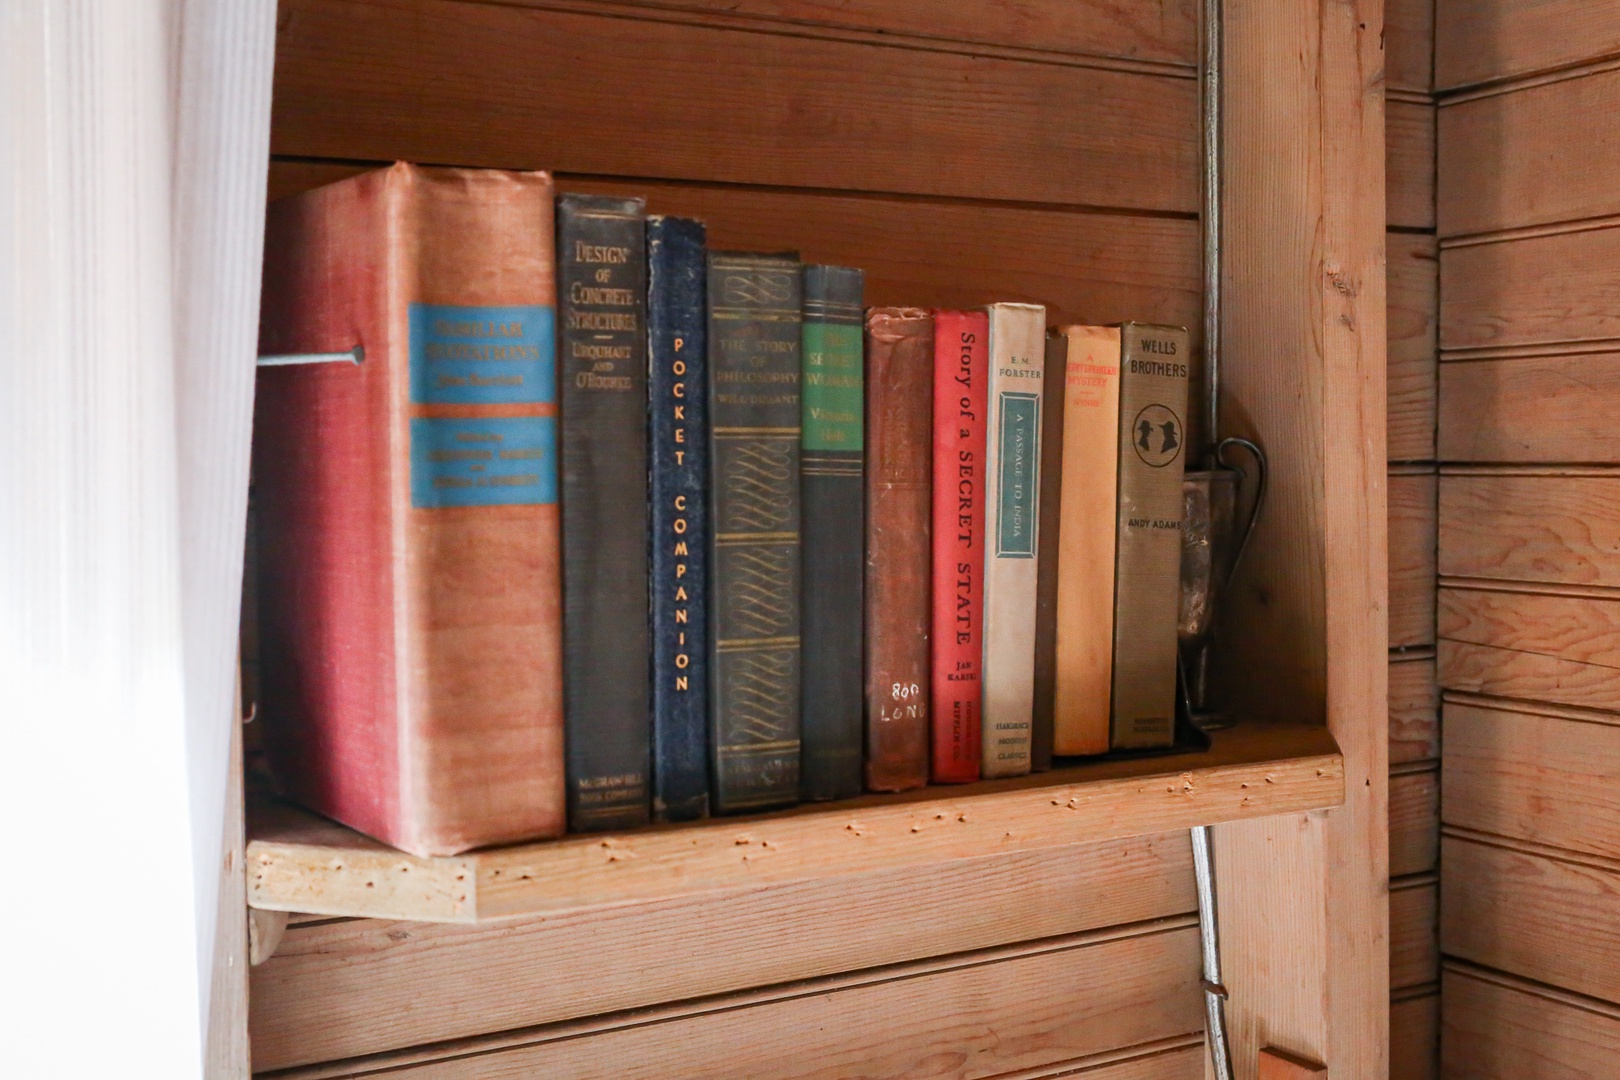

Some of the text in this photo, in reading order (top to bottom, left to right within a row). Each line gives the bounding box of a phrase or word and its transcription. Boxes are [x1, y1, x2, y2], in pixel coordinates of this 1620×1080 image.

[575, 240, 629, 264] DESIGN
[595, 268, 612, 283] OF
[571, 282, 634, 306] CONCRETE
[1141, 339, 1177, 355] WELLS
[999, 368, 1041, 379] FORSTER
[1130, 361, 1187, 378] BROTHERS
[1013, 414, 1024, 538] A PASSAGE TO INDIA
[955, 332, 976, 646] Story of a SECRET STATE
[672, 337, 689, 691] POCKET COMPANION
[1128, 518, 1182, 530] ANDY ADAMS
[956, 661, 972, 671] JAN
